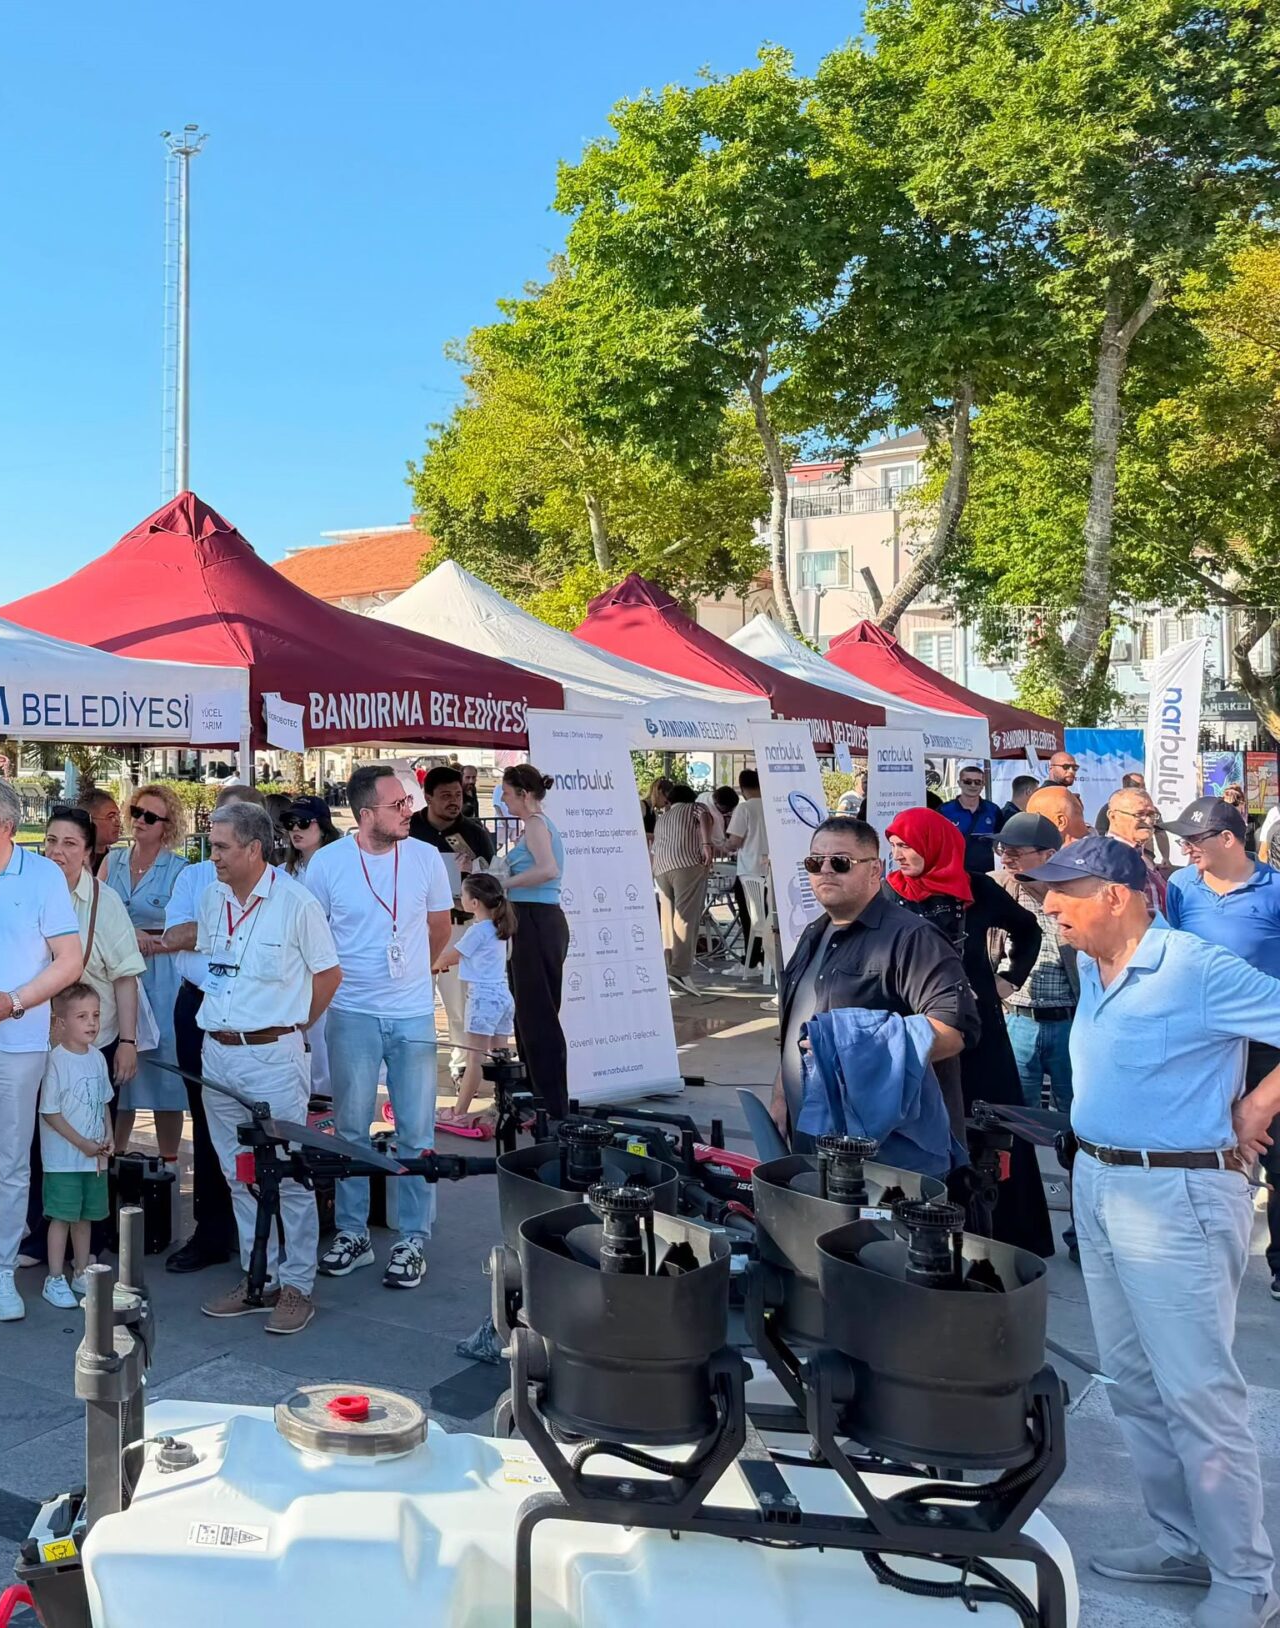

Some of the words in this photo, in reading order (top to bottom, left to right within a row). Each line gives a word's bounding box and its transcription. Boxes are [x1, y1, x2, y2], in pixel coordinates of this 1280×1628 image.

[22, 690, 190, 729] BELEDİYESİ
[201, 706, 223, 718] YÜCEL
[308, 690, 425, 730] BANDIRMA
[430, 690, 529, 733] BELEDİYESİ
[202, 721, 222, 731] TARIM
[658, 719, 700, 738] BANDIRMA
[697, 721, 738, 741] BELEDİYESİ
[765, 742, 803, 761] narbulut
[877, 745, 913, 762] narbulut
[1157, 687, 1187, 805] narbulut
[555, 769, 615, 791] narbulut
[592, 1064, 644, 1077] www.narbulut.com
